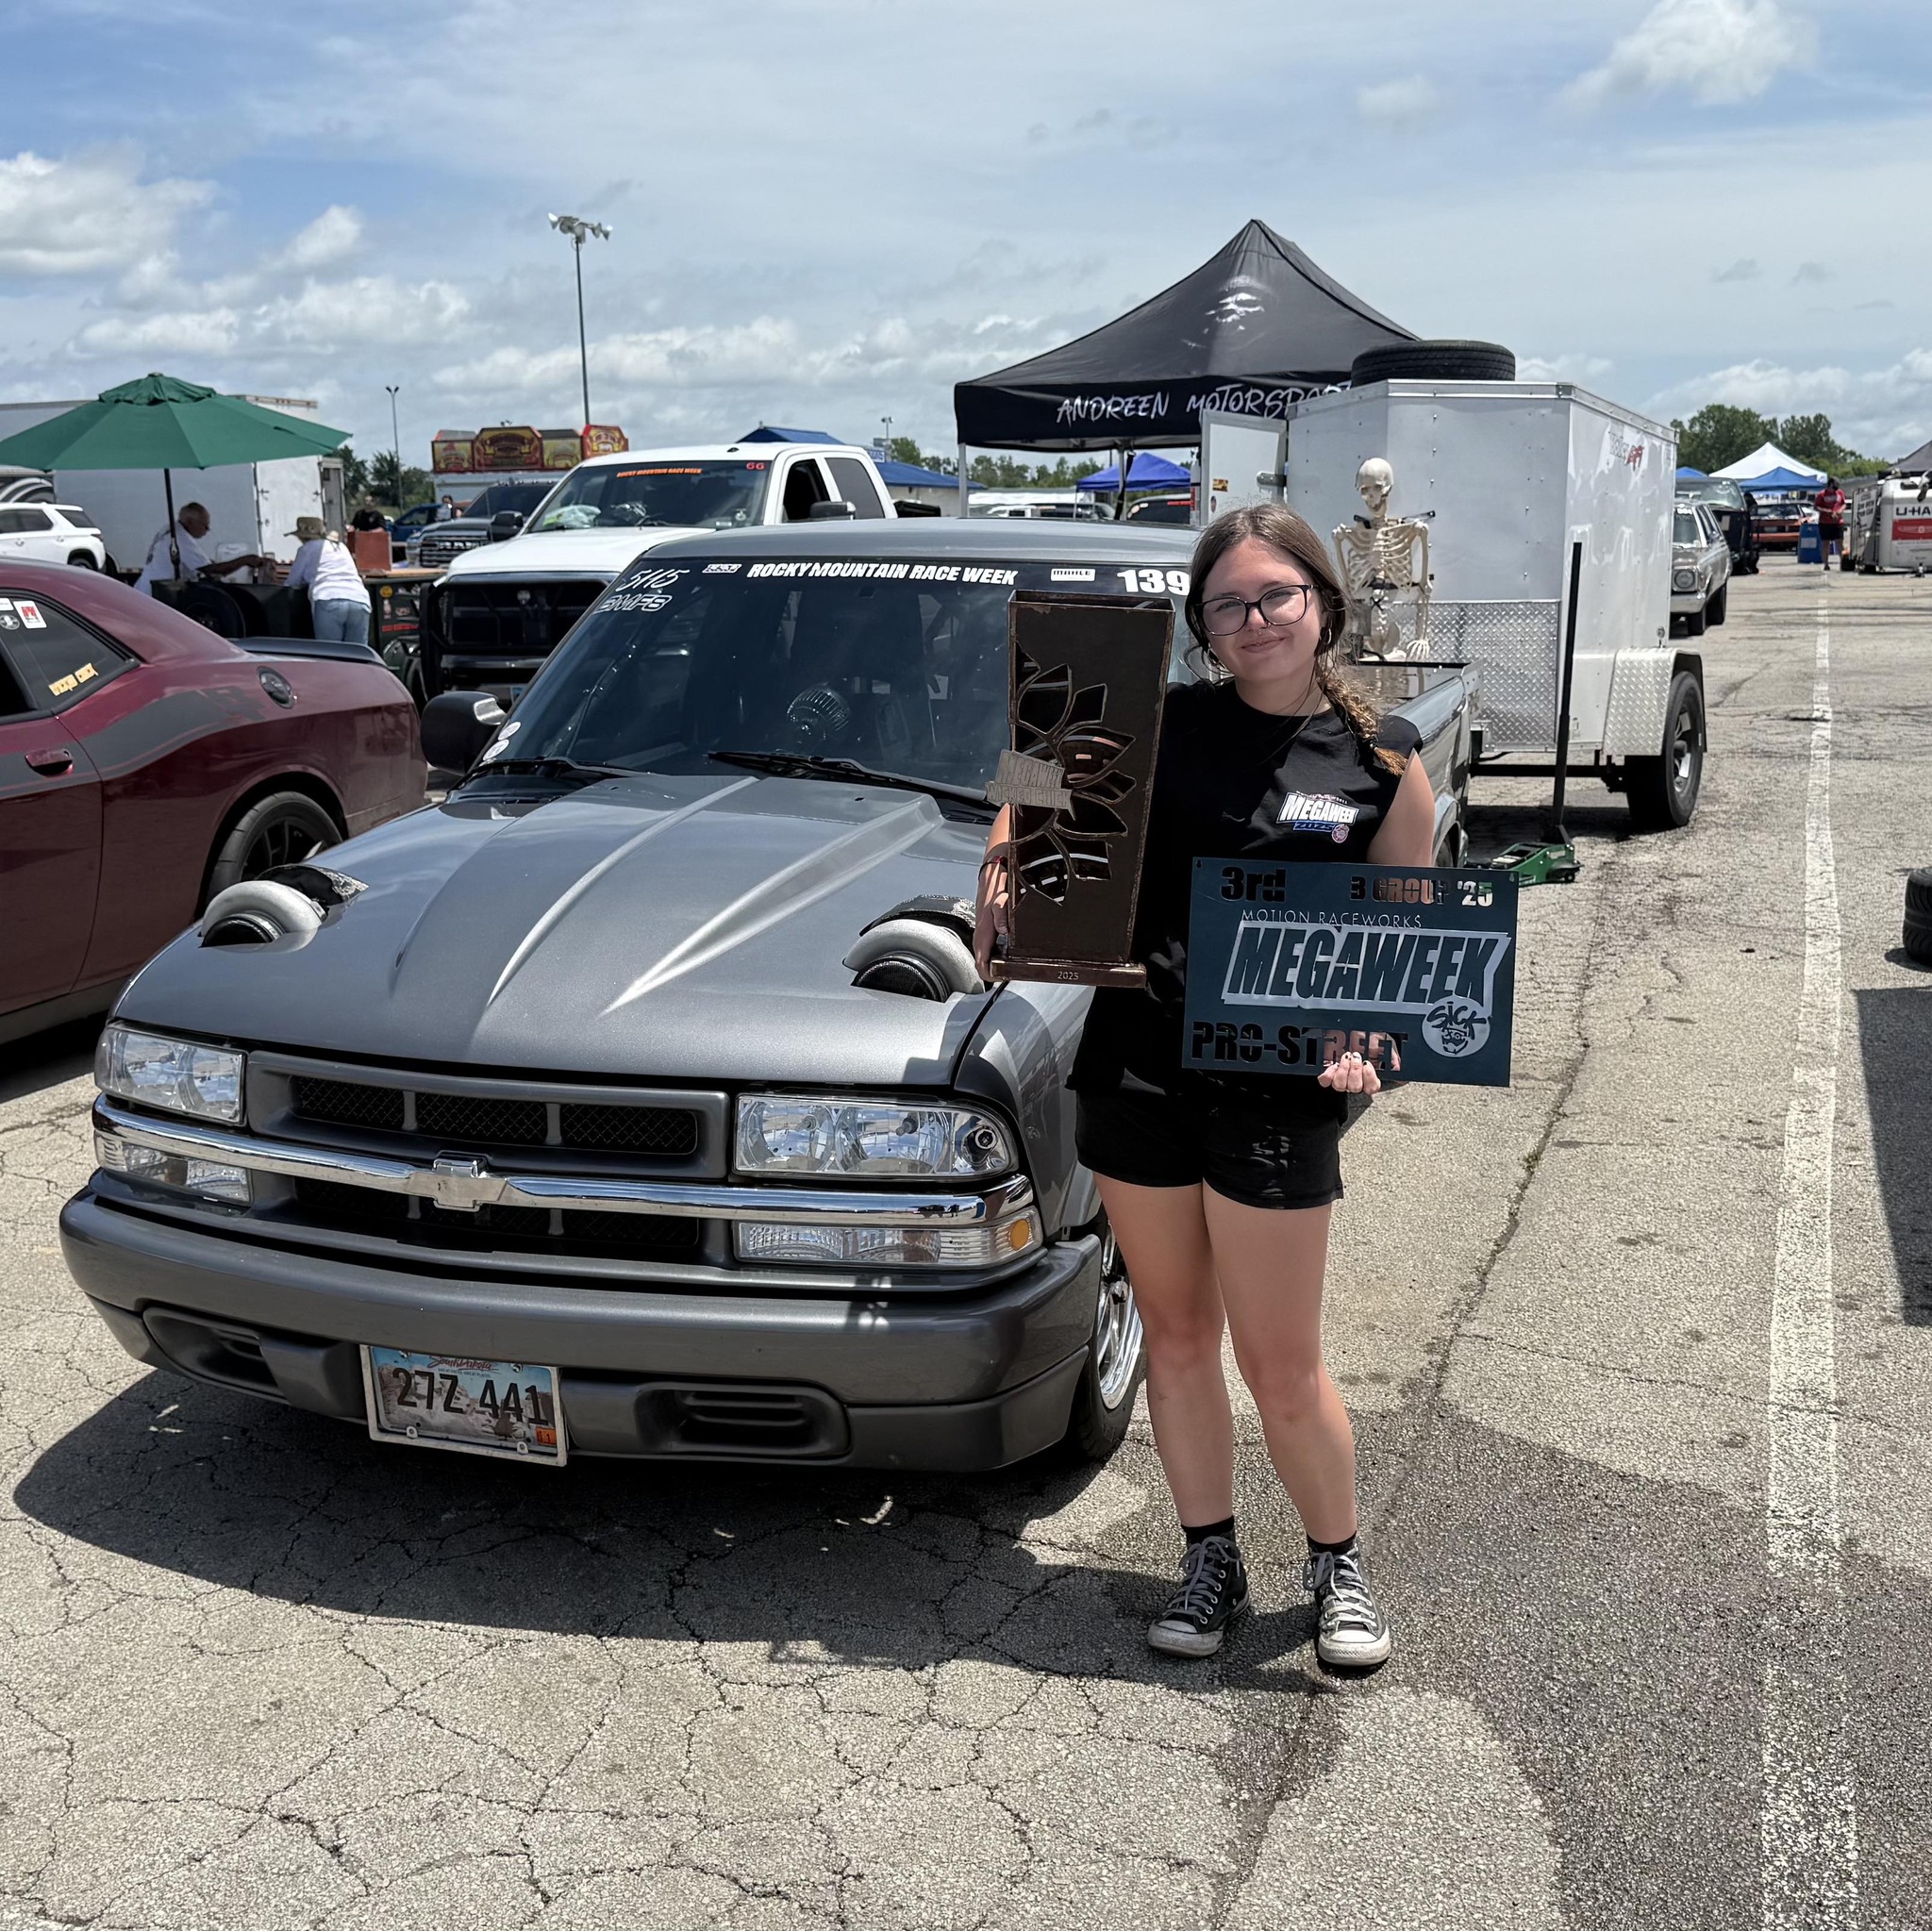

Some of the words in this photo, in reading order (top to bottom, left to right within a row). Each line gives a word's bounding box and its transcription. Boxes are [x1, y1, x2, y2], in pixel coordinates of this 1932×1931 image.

[1056, 391, 1170, 427] ANDREEN
[747, 562, 813, 577] ROCKY
[808, 562, 910, 579] MOUNTAIN
[908, 564, 961, 581] RACE
[961, 568, 1018, 586] WEEK
[1116, 569, 1190, 596] 139
[1221, 867, 1287, 903] 3rd
[1241, 909, 1310, 924] MOTION
[1319, 911, 1423, 929] RACEWORKS
[1058, 971, 1079, 980] 2025
[1227, 927, 1499, 1007] MEGAWEEK
[1191, 1022, 1408, 1072] PRO-STREET
[392, 1368, 464, 1414] 27Z
[479, 1379, 549, 1425] 441
